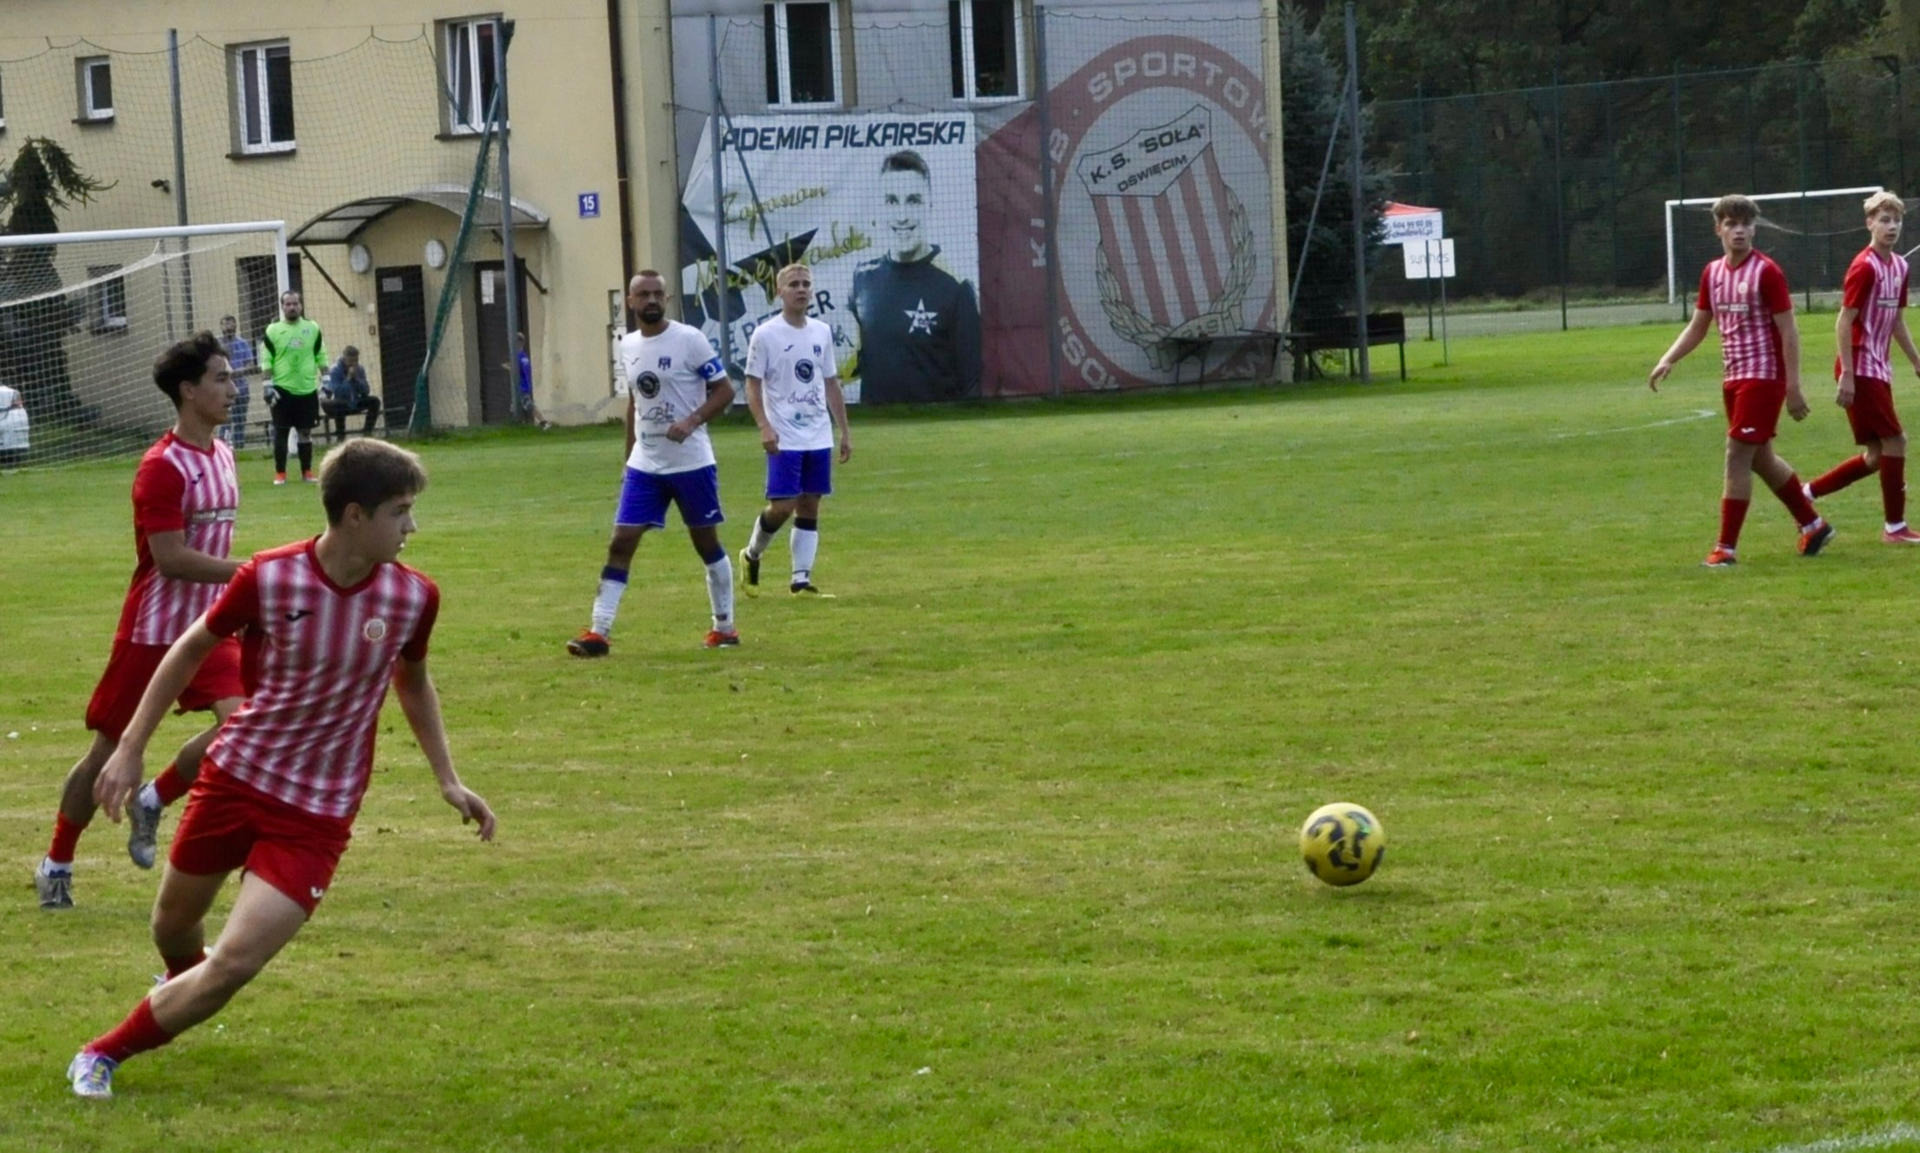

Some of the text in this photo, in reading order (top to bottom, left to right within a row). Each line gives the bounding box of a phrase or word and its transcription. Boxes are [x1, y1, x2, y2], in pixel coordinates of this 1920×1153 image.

[824, 121, 966, 149] PIŁKARSKA
[1090, 153, 1131, 184] K.S.
[582, 195, 595, 211] 15
